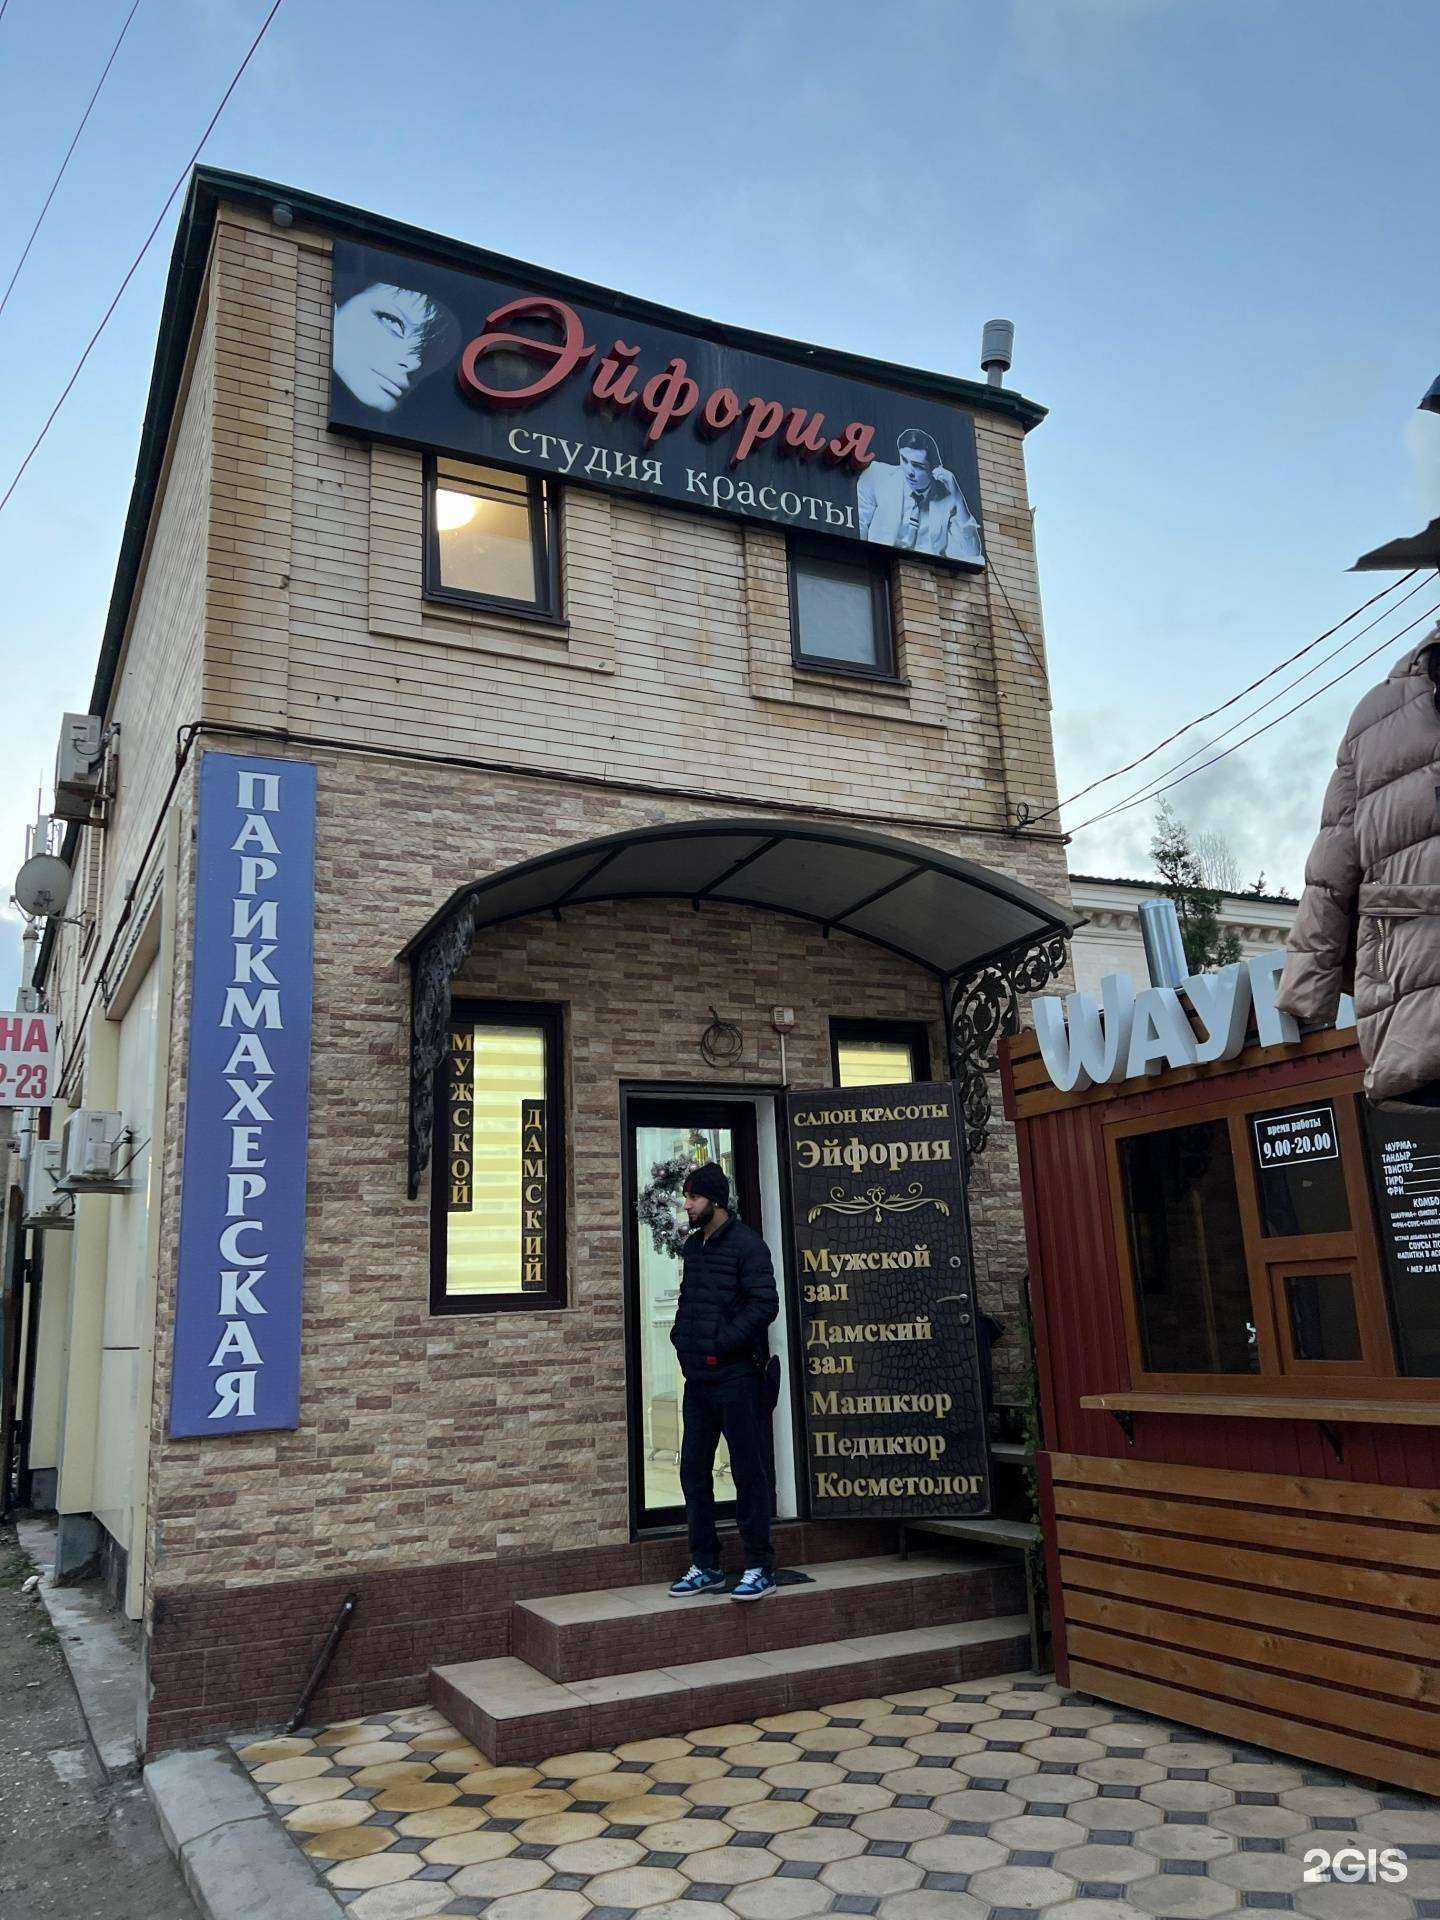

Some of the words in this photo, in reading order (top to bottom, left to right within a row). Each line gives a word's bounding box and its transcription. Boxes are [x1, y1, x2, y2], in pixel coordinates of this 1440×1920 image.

[458, 296, 878, 463] Эйфория
[508, 426, 664, 485] студия
[685, 465, 857, 530] красоты
[207, 770, 285, 1419] ПАРИКМАХЕРСКАЯ
[450, 1033, 473, 1204] МУЖСКОЙ
[793, 1108, 857, 1127] САЛОН
[860, 1103, 949, 1123] КРАСОТЫ
[796, 1137, 951, 1174] Эйфория
[1263, 1132, 1331, 1159] 9.00-20.00
[523, 1109, 545, 1281] ДАМСКИЙ
[801, 1245, 931, 1277] Мужской
[803, 1283, 849, 1302] зал
[806, 1316, 933, 1350] Дамский
[808, 1356, 854, 1375] зал
[810, 1390, 952, 1418] Маникюр
[812, 1431, 947, 1461] Педикюр
[815, 1472, 984, 1498] Косметолог
